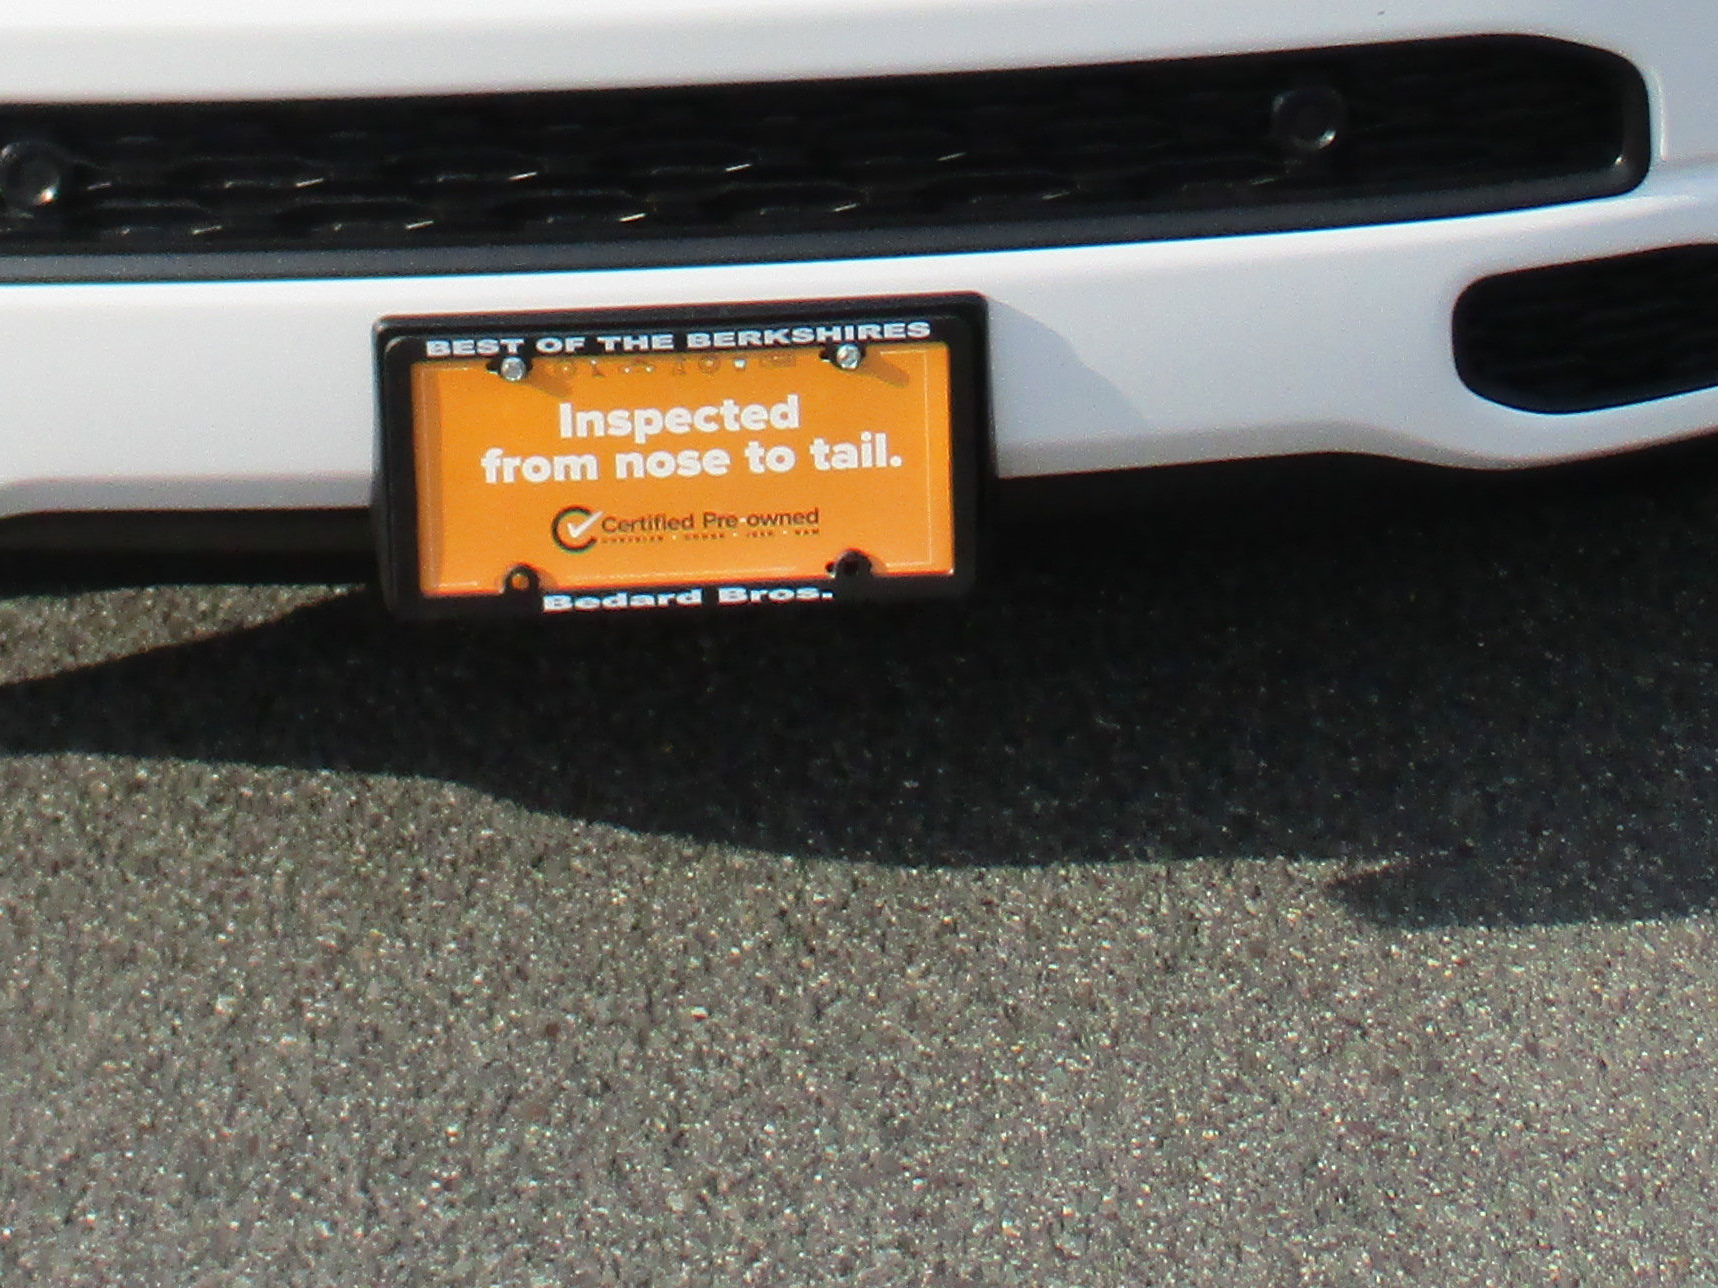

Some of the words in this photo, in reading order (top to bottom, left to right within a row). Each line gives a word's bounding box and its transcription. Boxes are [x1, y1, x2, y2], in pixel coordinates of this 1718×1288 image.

[425, 337, 525, 358] BEST
[535, 336, 586, 355] OF
[597, 333, 675, 353] THE
[686, 321, 931, 349] BERKSHIRES
[558, 394, 801, 444] Inspected
[480, 448, 599, 484] from
[614, 446, 732, 480] nose
[744, 440, 796, 474] to
[809, 431, 903, 470] tail.
[600, 513, 694, 533] Certified
[702, 507, 820, 529] Pre-owned
[542, 588, 703, 612] Bedard
[718, 586, 833, 605] Bros.
